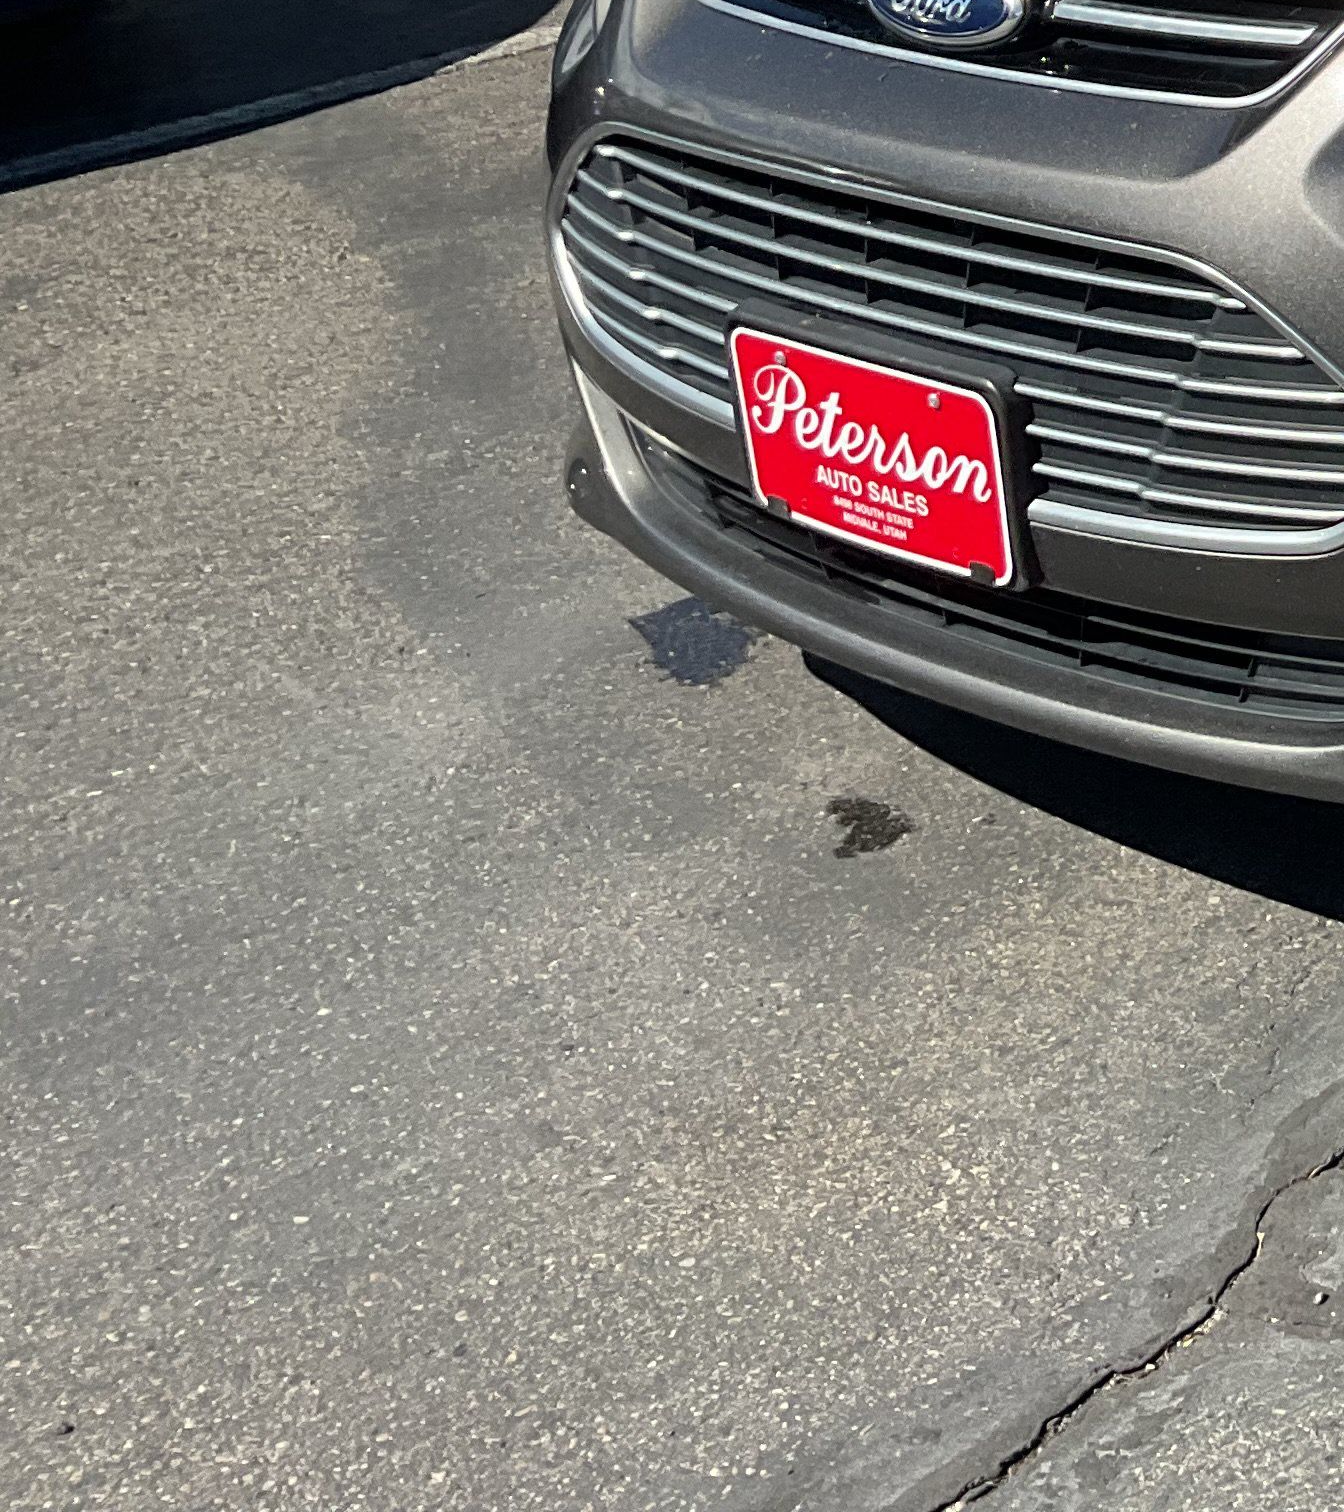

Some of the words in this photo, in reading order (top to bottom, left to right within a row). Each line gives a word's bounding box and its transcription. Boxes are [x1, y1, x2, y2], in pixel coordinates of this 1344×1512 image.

[751, 365, 992, 502] Peterson
[816, 465, 862, 497] AUTO
[867, 480, 929, 517] SALES
